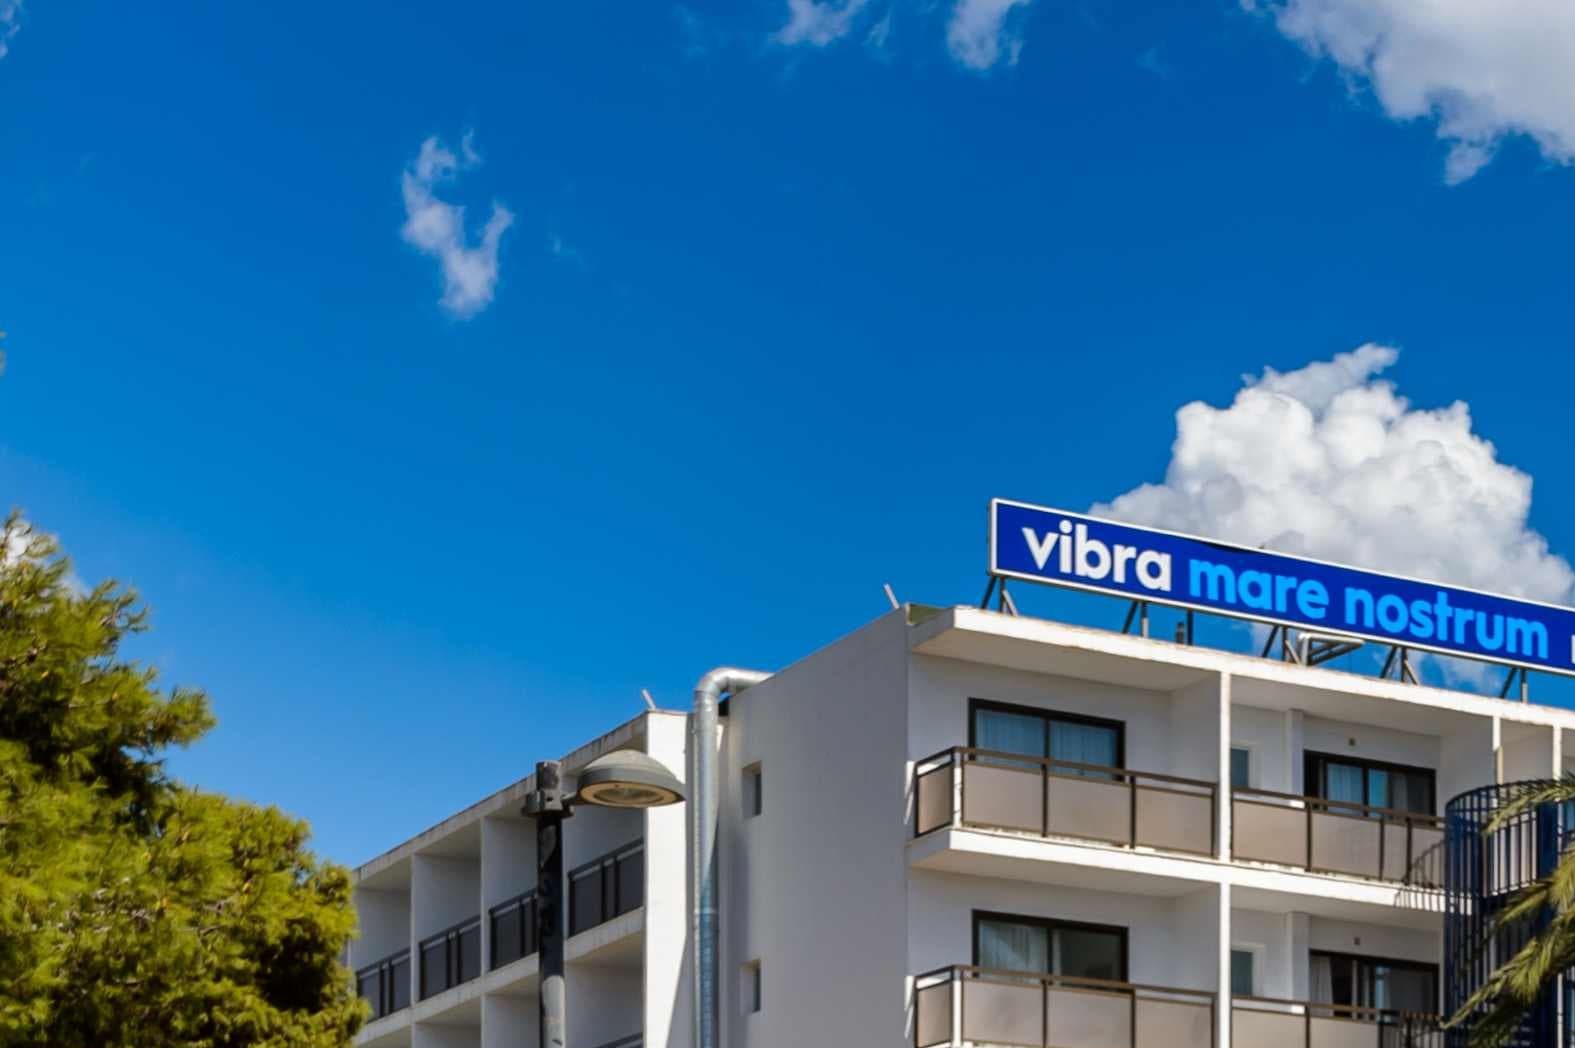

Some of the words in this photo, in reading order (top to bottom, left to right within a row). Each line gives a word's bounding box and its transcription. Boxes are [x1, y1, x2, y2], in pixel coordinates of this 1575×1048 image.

[1022, 519, 1172, 592] vibra
[1189, 558, 1329, 619] mare
[1345, 587, 1549, 659] nostrum
